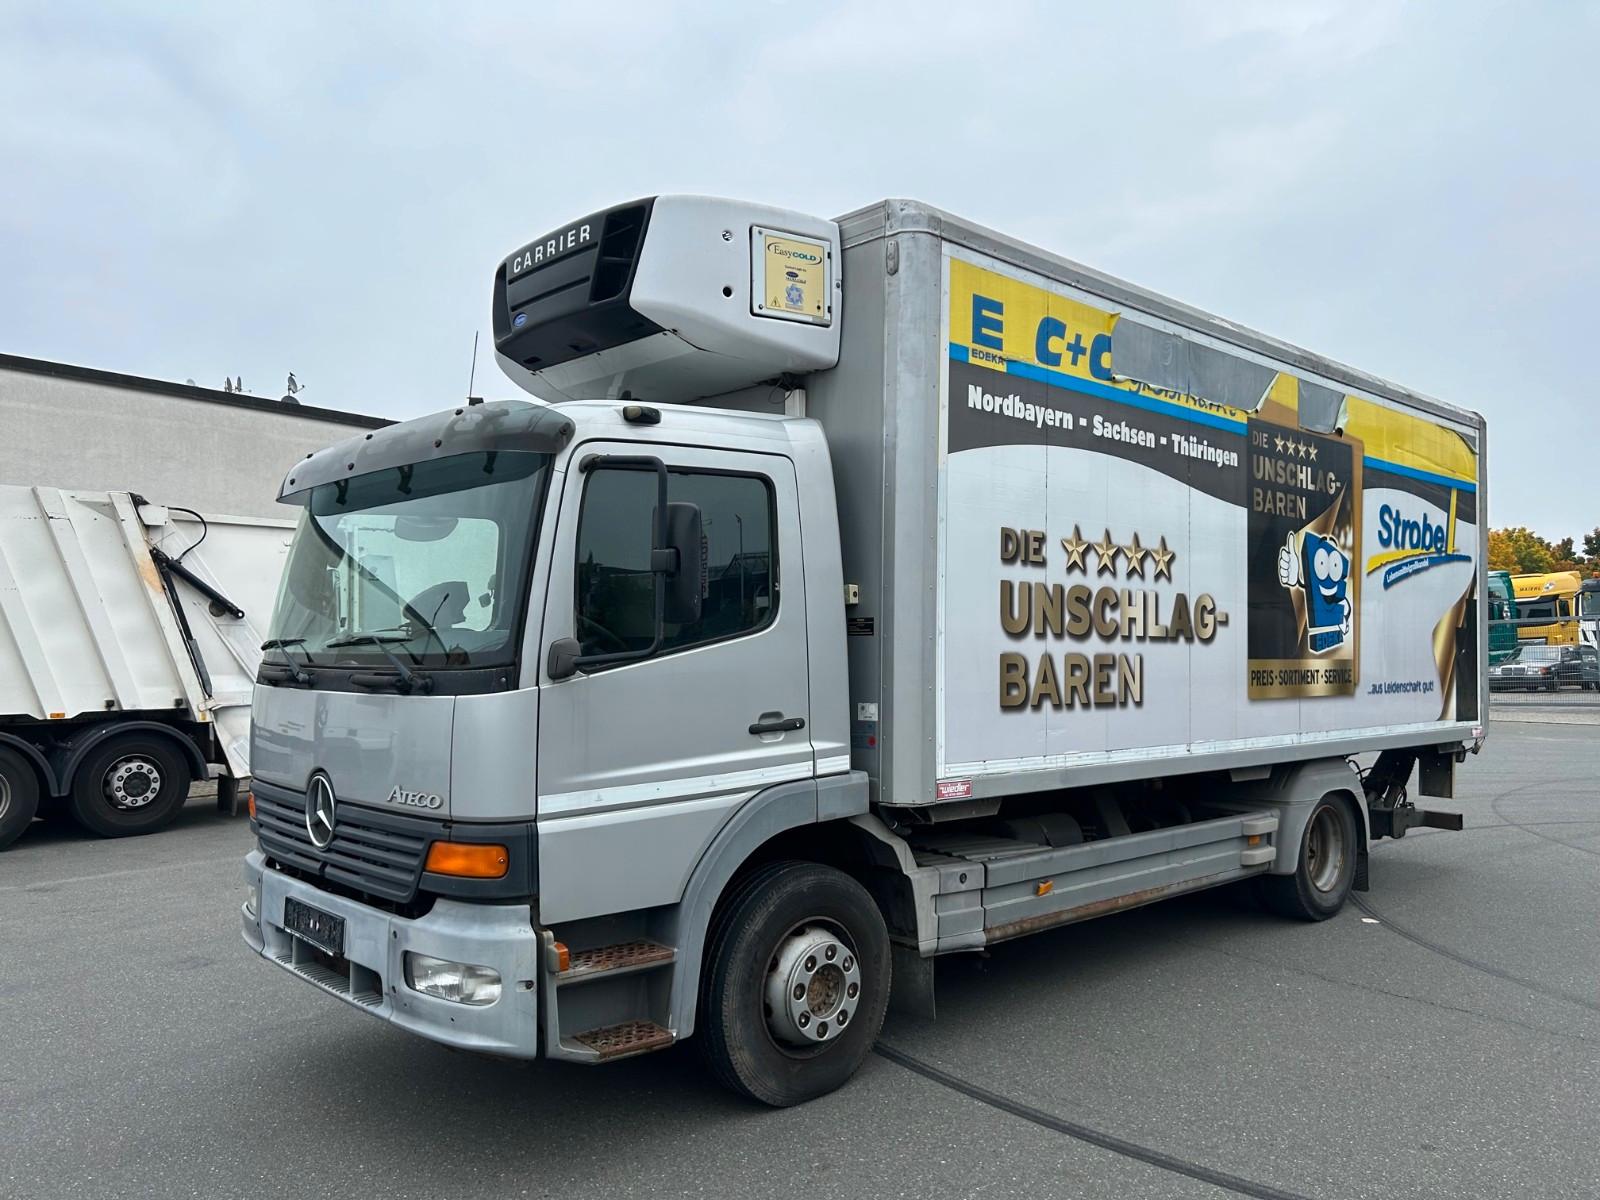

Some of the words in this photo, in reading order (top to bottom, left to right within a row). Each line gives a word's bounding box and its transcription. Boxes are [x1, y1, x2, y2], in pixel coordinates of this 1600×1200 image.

[513, 224, 591, 273] CARRIER
[972, 293, 1004, 352] E
[971, 348, 1006, 365] EDEKA
[967, 384, 1074, 430] Nordbayern
[1092, 414, 1155, 448] Sachsen
[1171, 433, 1239, 468] Thüringen
[1252, 431, 1269, 449] DIE
[1253, 454, 1342, 496] UNSCHLAG-
[1253, 487, 1307, 520] BAREN
[1000, 526, 1046, 564] DIE
[1000, 579, 1229, 641] UNSCHLAG-
[1000, 652, 1144, 708] BAREN
[1250, 668, 1274, 687] PREIS
[1278, 668, 1320, 687] SORTIMENT
[1323, 667, 1352, 685] SERVICE
[1384, 680, 1422, 694] Leidenschaft
